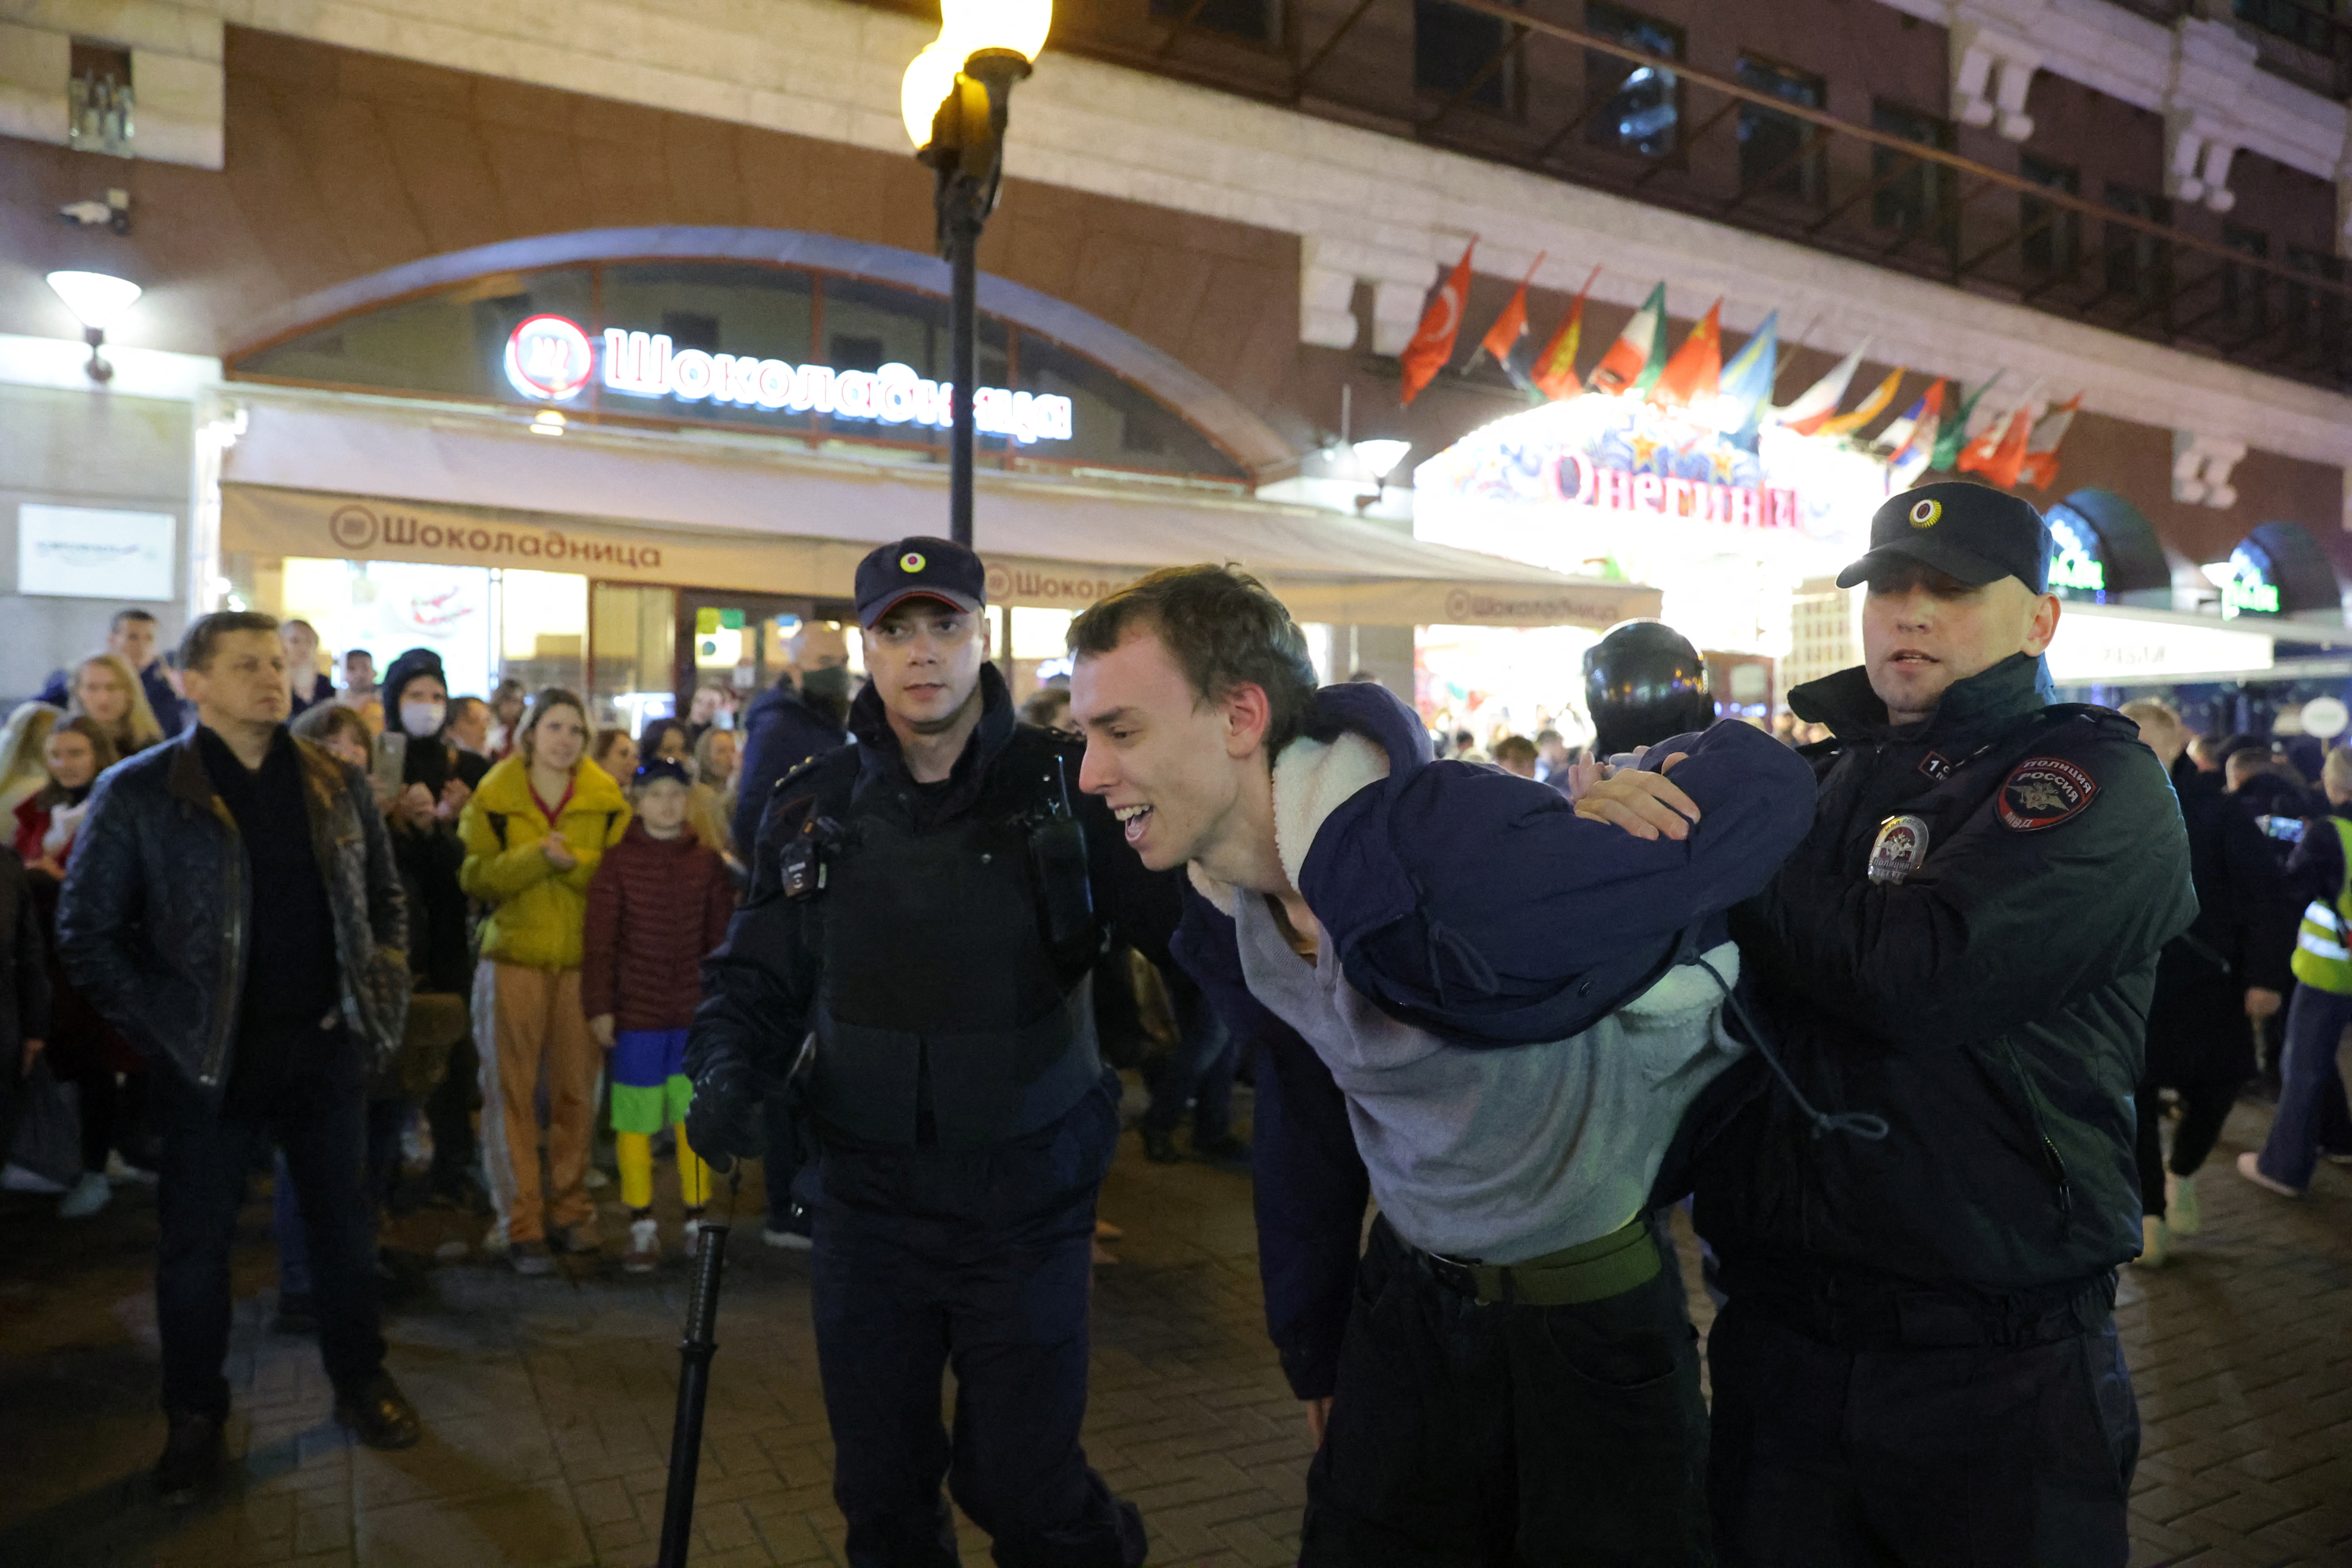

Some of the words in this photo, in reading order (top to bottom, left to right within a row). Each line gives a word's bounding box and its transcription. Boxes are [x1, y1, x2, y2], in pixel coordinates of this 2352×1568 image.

[383, 517, 661, 569] Шоколадница
[2017, 772, 2078, 803] РОССИЯ
[2024, 760, 2092, 794] ПОЛИЦИЯ
[2005, 811, 2033, 828] МВД
